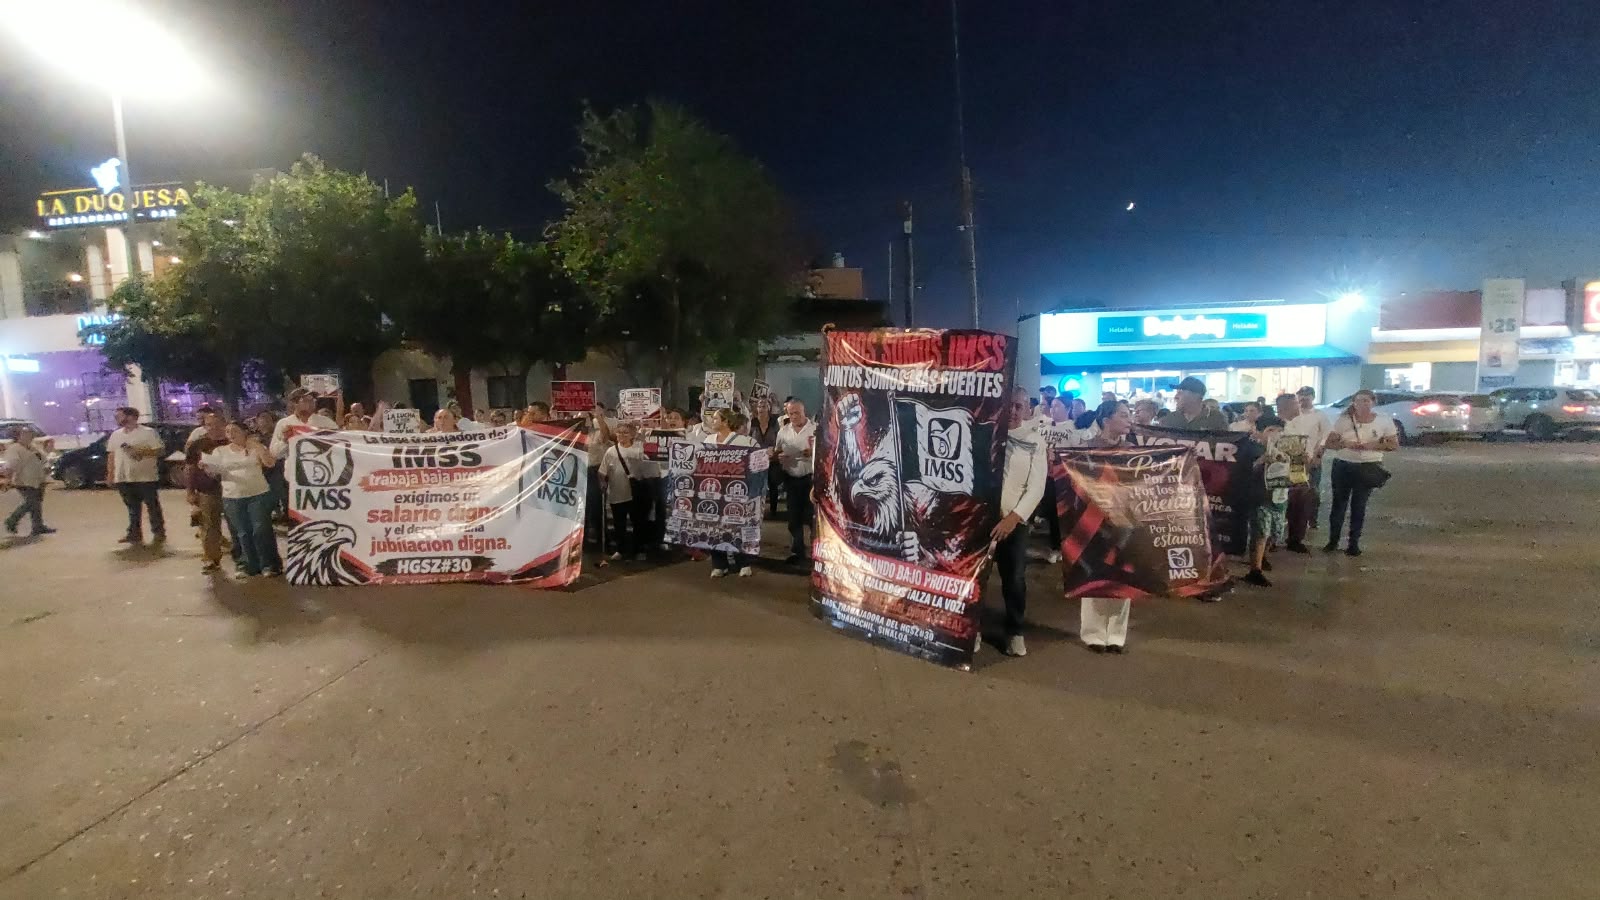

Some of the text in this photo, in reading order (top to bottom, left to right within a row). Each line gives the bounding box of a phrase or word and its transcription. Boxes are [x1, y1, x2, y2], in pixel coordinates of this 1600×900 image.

[36, 198, 66, 217] LA
[947, 334, 1007, 371] IMSS
[823, 364, 863, 388] JUNTOS
[864, 366, 908, 392] SOMOS
[939, 370, 1004, 398] FUERTES
[391, 443, 482, 468] IMSS
[696, 449, 749, 459] TRABAJADORES
[703, 455, 743, 464] DEL IMSS
[671, 460, 694, 471] IMSS
[924, 458, 965, 484] IMSS
[369, 473, 419, 487] trabaja
[420, 470, 452, 486] baja
[1143, 473, 1166, 485] Por
[394, 490, 460, 506] exigimos
[537, 482, 577, 507] IMSS
[1157, 484, 1175, 495] los
[295, 487, 352, 511] IMSS
[367, 505, 442, 523] salario
[384, 526, 392, 538] y
[394, 524, 405, 535] el
[1150, 524, 1166, 534] Por
[1168, 523, 1183, 532] los
[457, 534, 513, 555] digna.
[1153, 533, 1205, 548] estamos
[397, 557, 473, 575] HGSZ#30
[896, 564, 922, 583] BAJO
[1168, 568, 1199, 580] IMSS
[931, 594, 944, 609] LA
[944, 598, 966, 614] VOZ!
[885, 618, 899, 630] DEL
